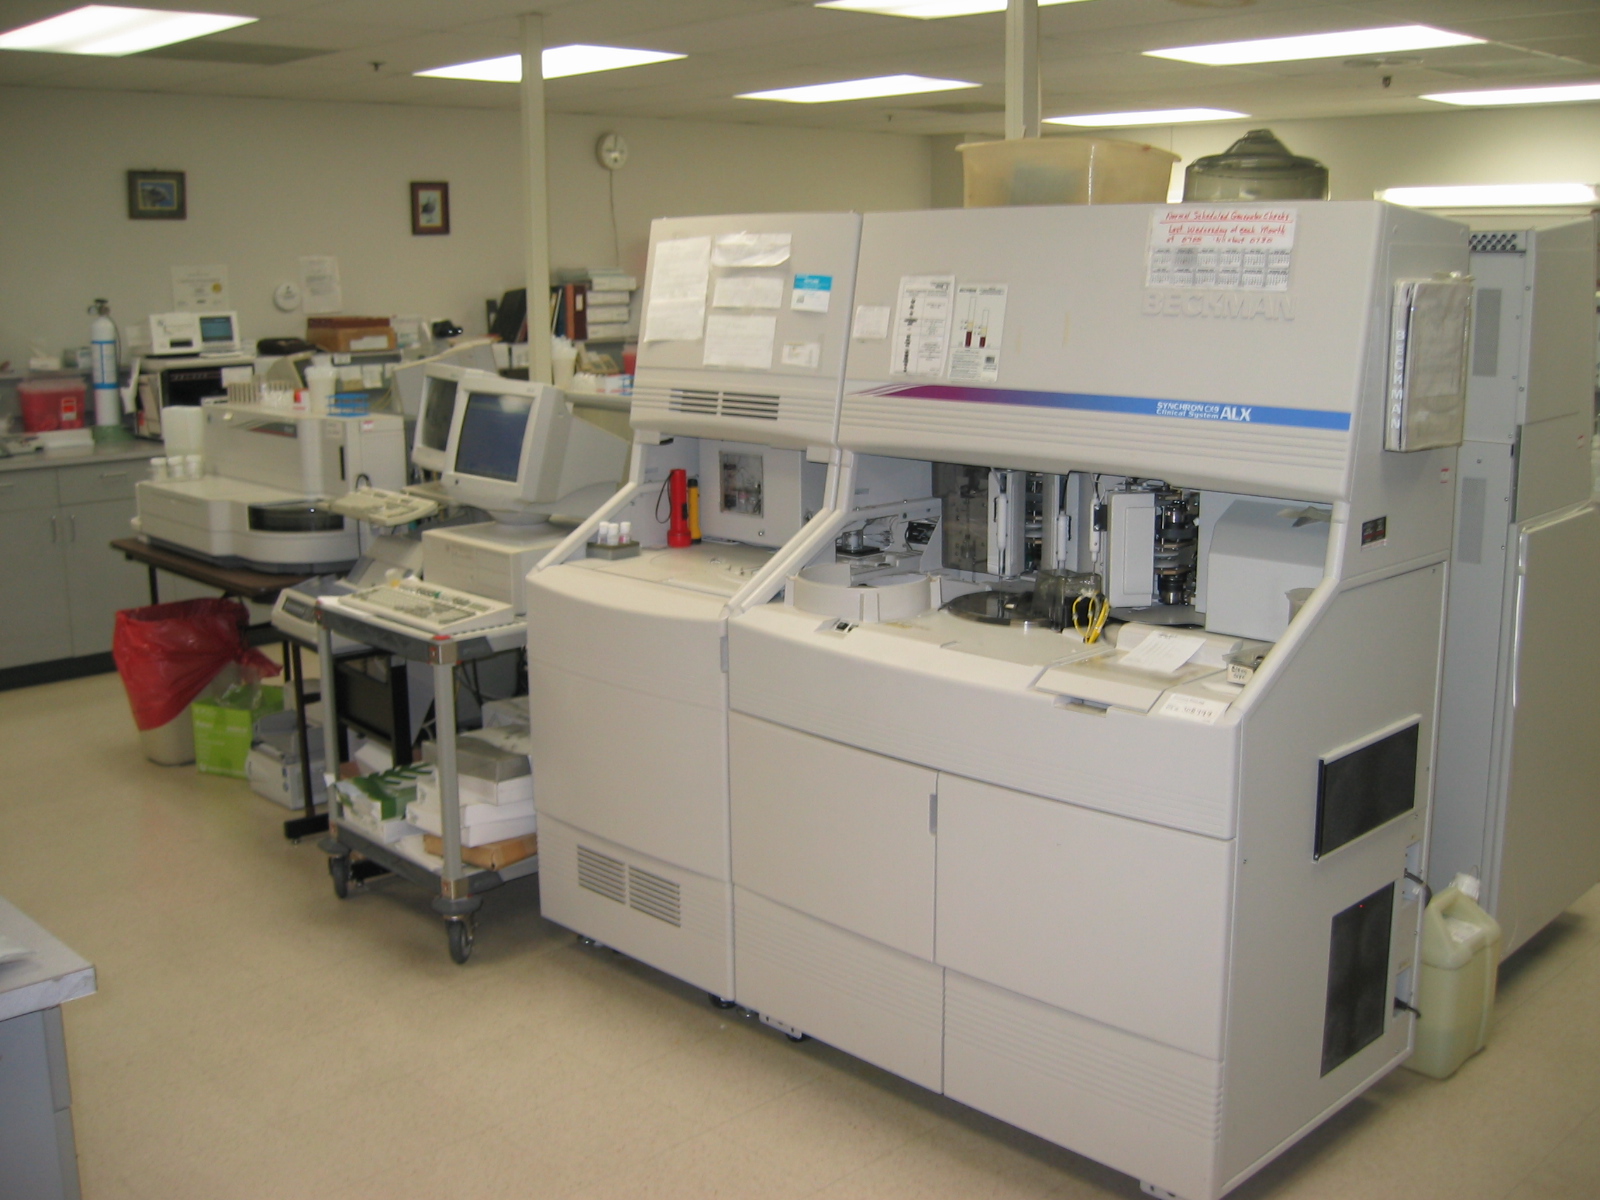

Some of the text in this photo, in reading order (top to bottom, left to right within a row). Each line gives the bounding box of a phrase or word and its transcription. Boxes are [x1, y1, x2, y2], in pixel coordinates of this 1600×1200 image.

[1193, 210, 1229, 221] Scheduled
[1168, 224, 1183, 234] Last
[1187, 224, 1228, 237] Wednesday
[1260, 224, 1287, 235] Month
[1142, 291, 1297, 321] BECKMAN
[1390, 330, 1405, 430] BECKMAN
[1156, 401, 1204, 412] SYNCHRON
[1156, 407, 1219, 420] Clinical System
[1219, 406, 1252, 422] ALX
